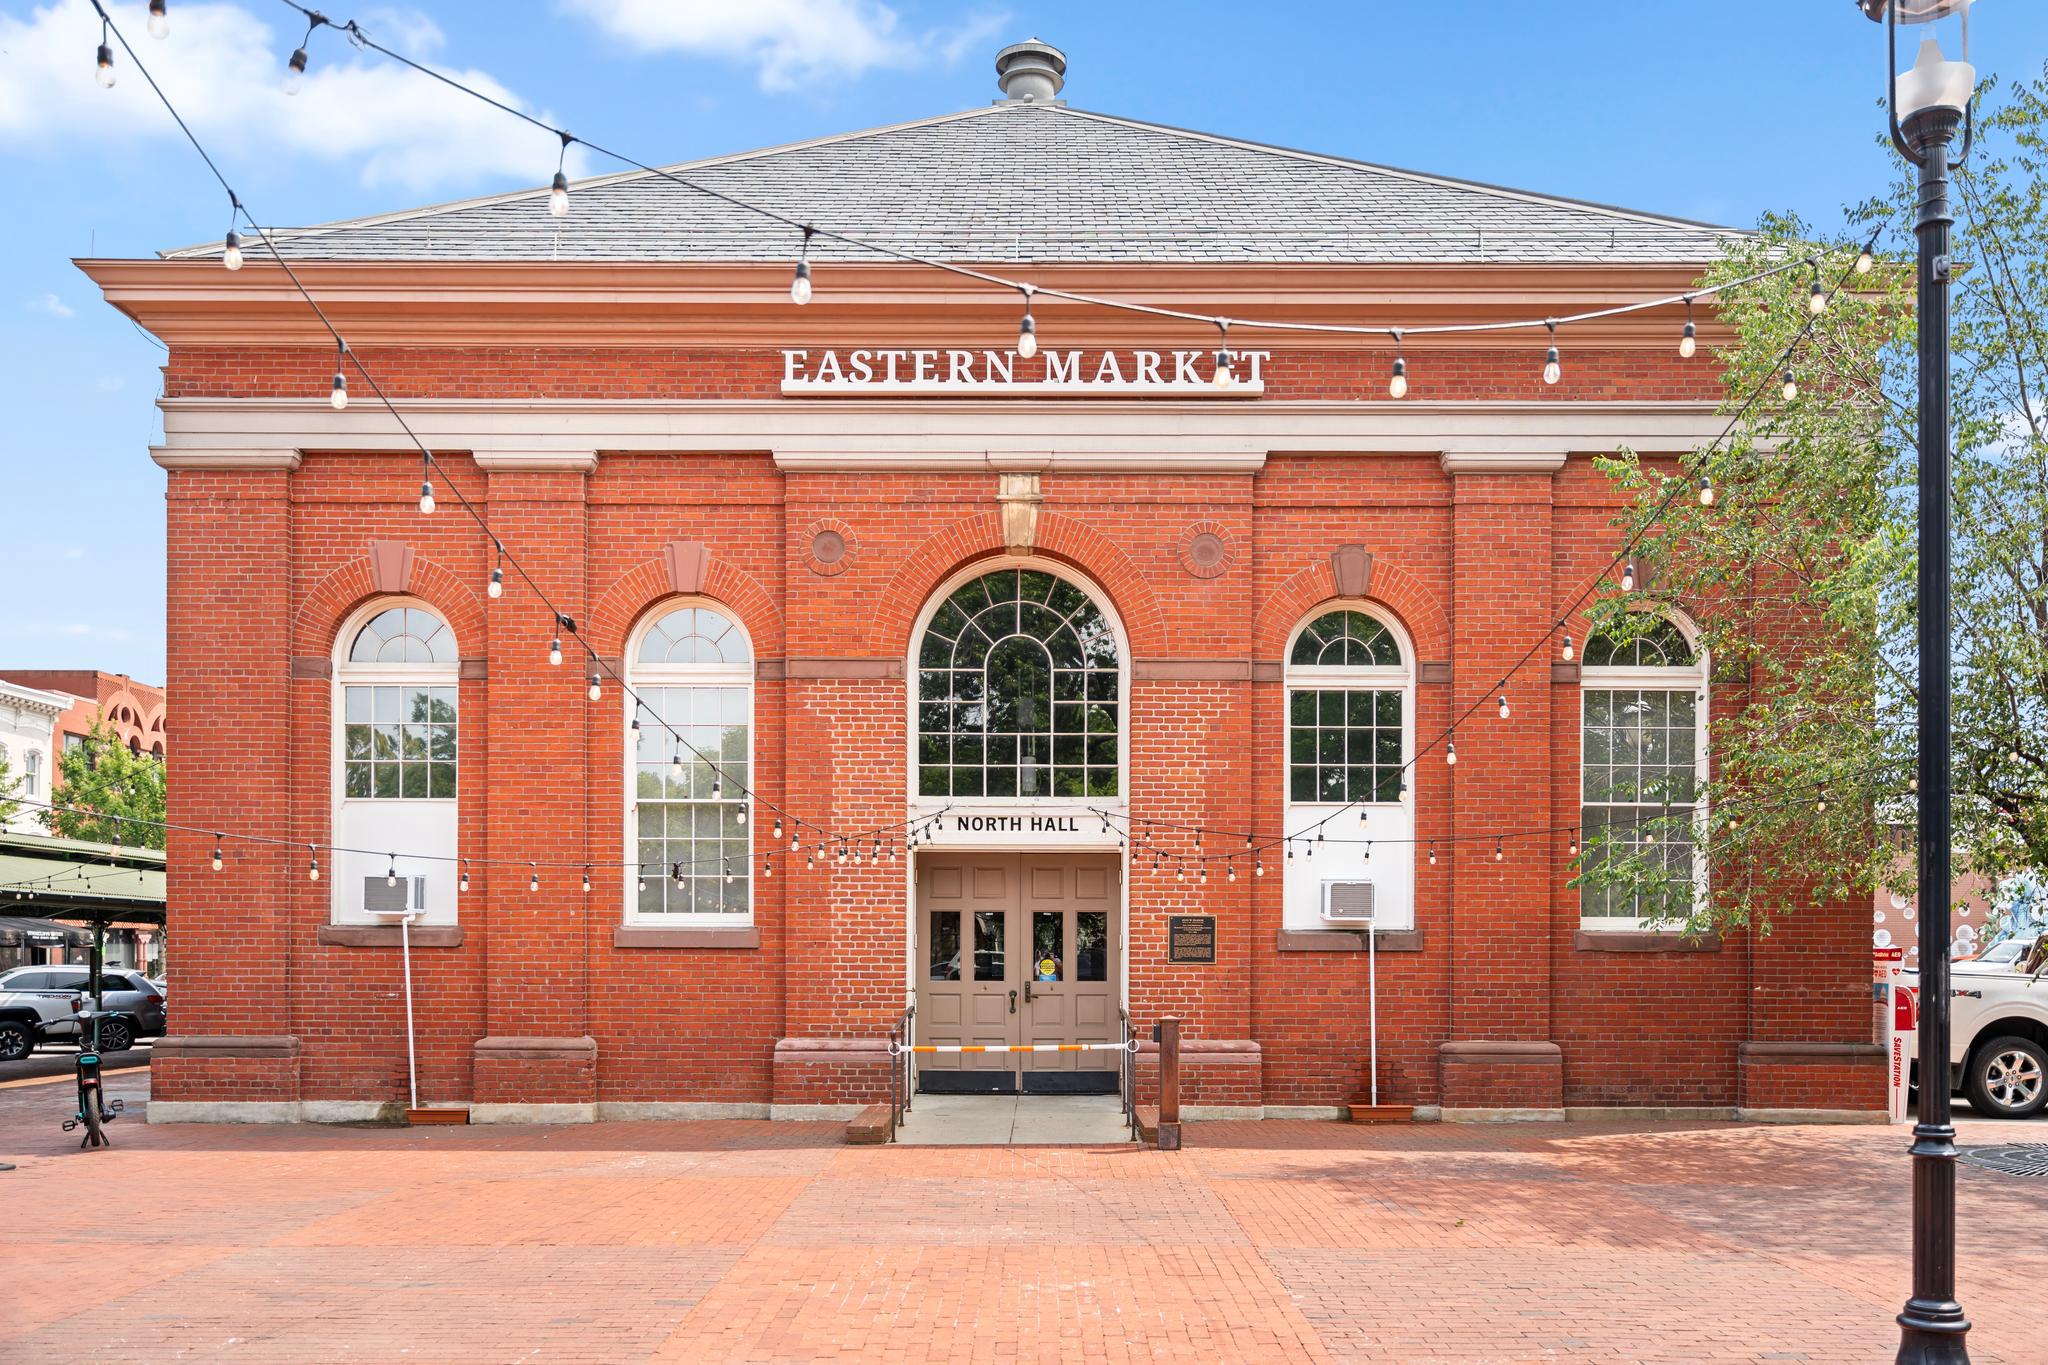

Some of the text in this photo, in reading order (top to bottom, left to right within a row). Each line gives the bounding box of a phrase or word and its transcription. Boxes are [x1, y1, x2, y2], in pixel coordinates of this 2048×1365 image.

[781, 350, 1270, 383] EASTERN MARKET
[957, 816, 1079, 831] NORTH HALL
[1893, 1036, 1902, 1088] SAVESTATION
